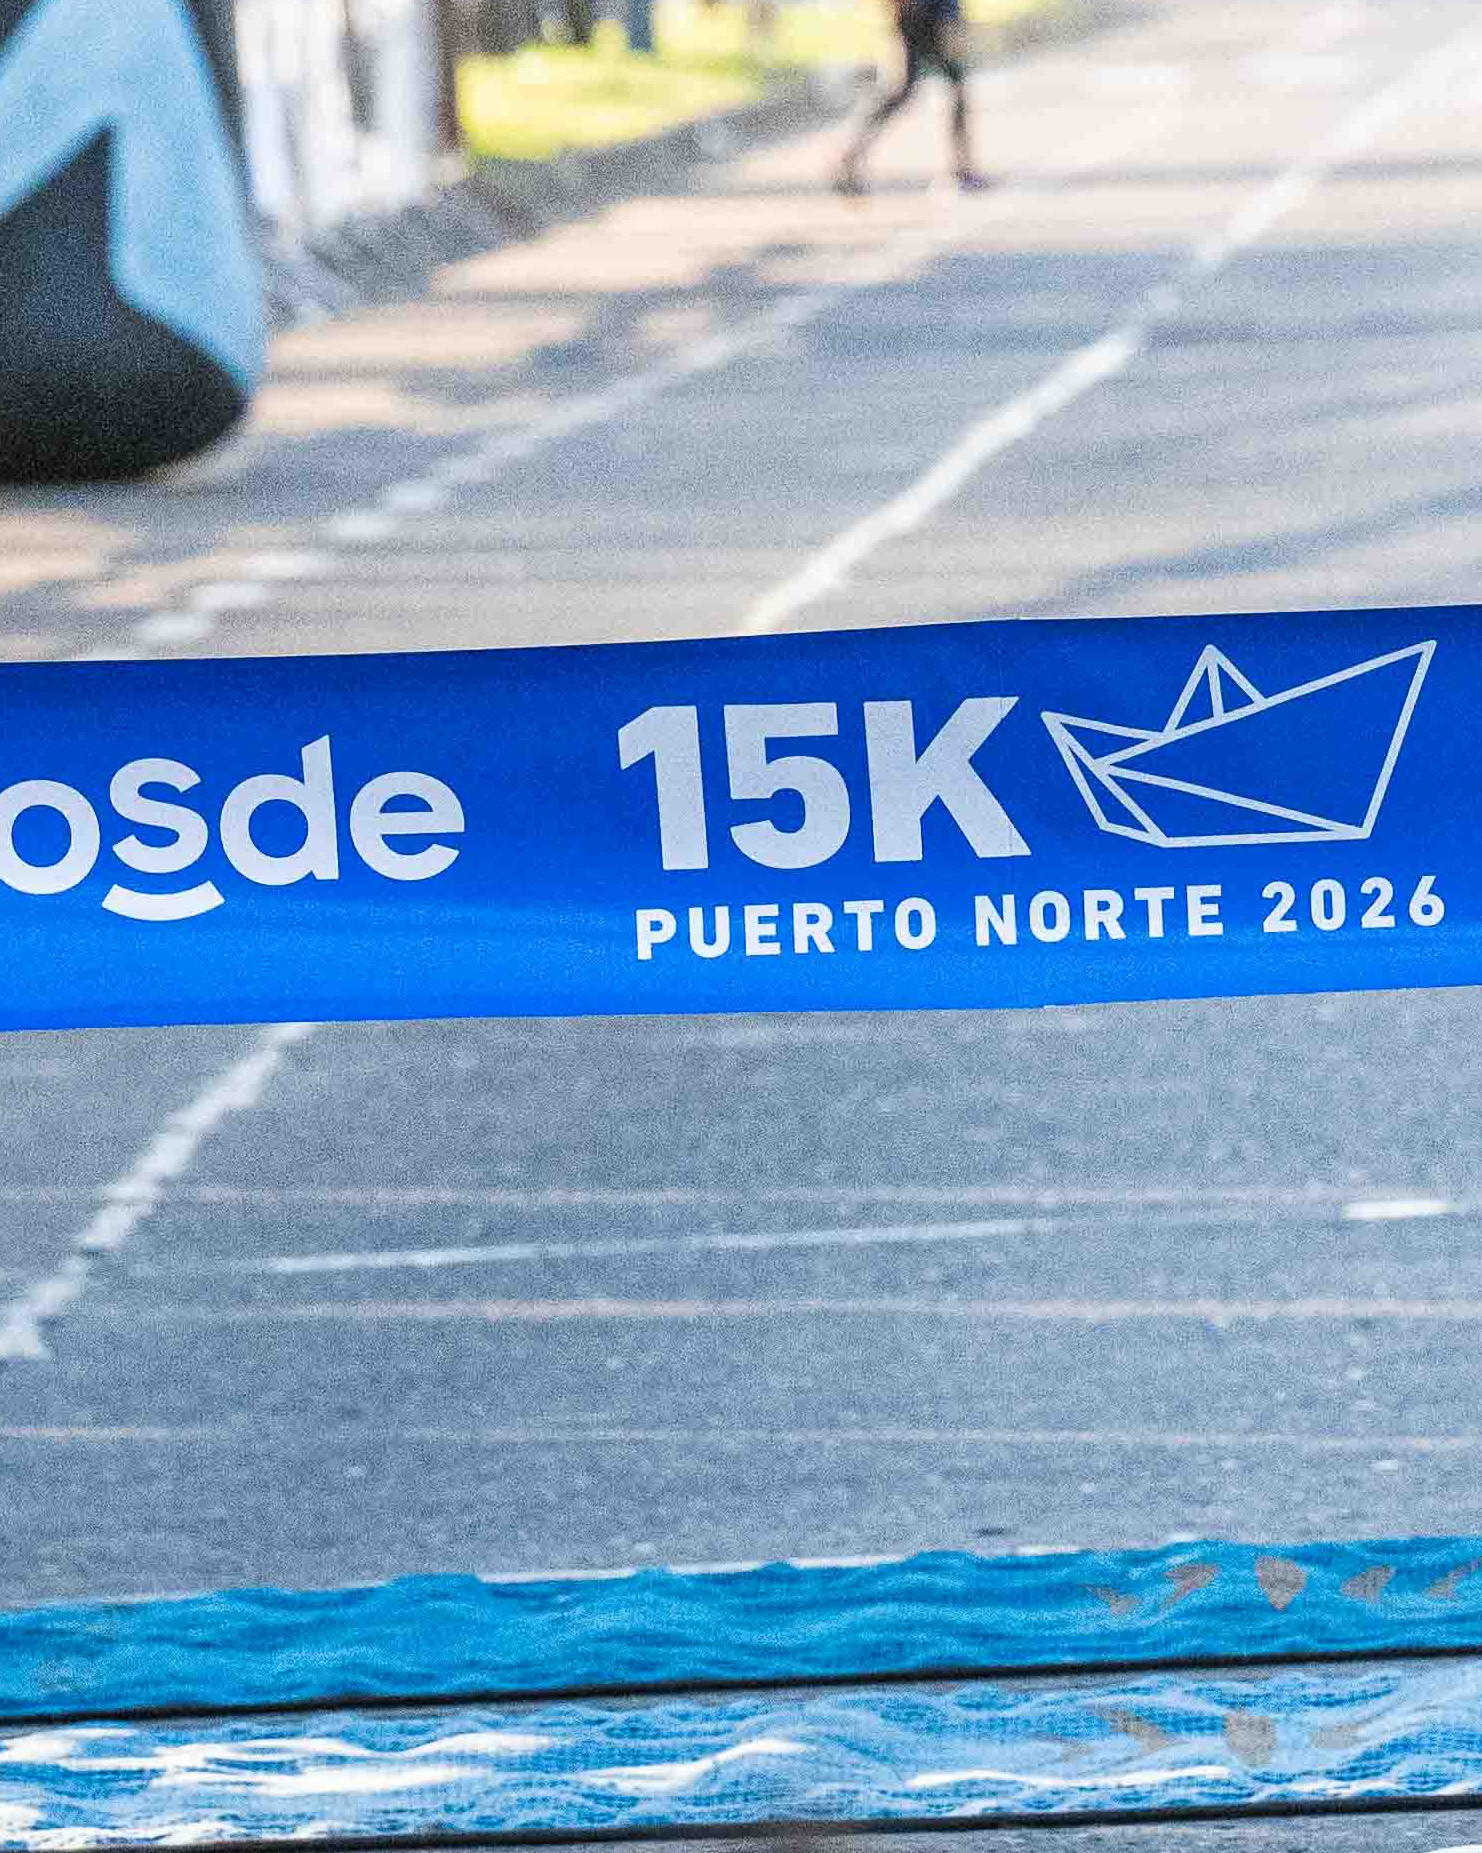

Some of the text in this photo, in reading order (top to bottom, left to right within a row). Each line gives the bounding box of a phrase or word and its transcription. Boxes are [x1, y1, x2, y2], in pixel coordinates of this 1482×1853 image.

[618, 696, 1031, 870] 15K
[636, 874, 1446, 960] PUERTO NORTE 2026
